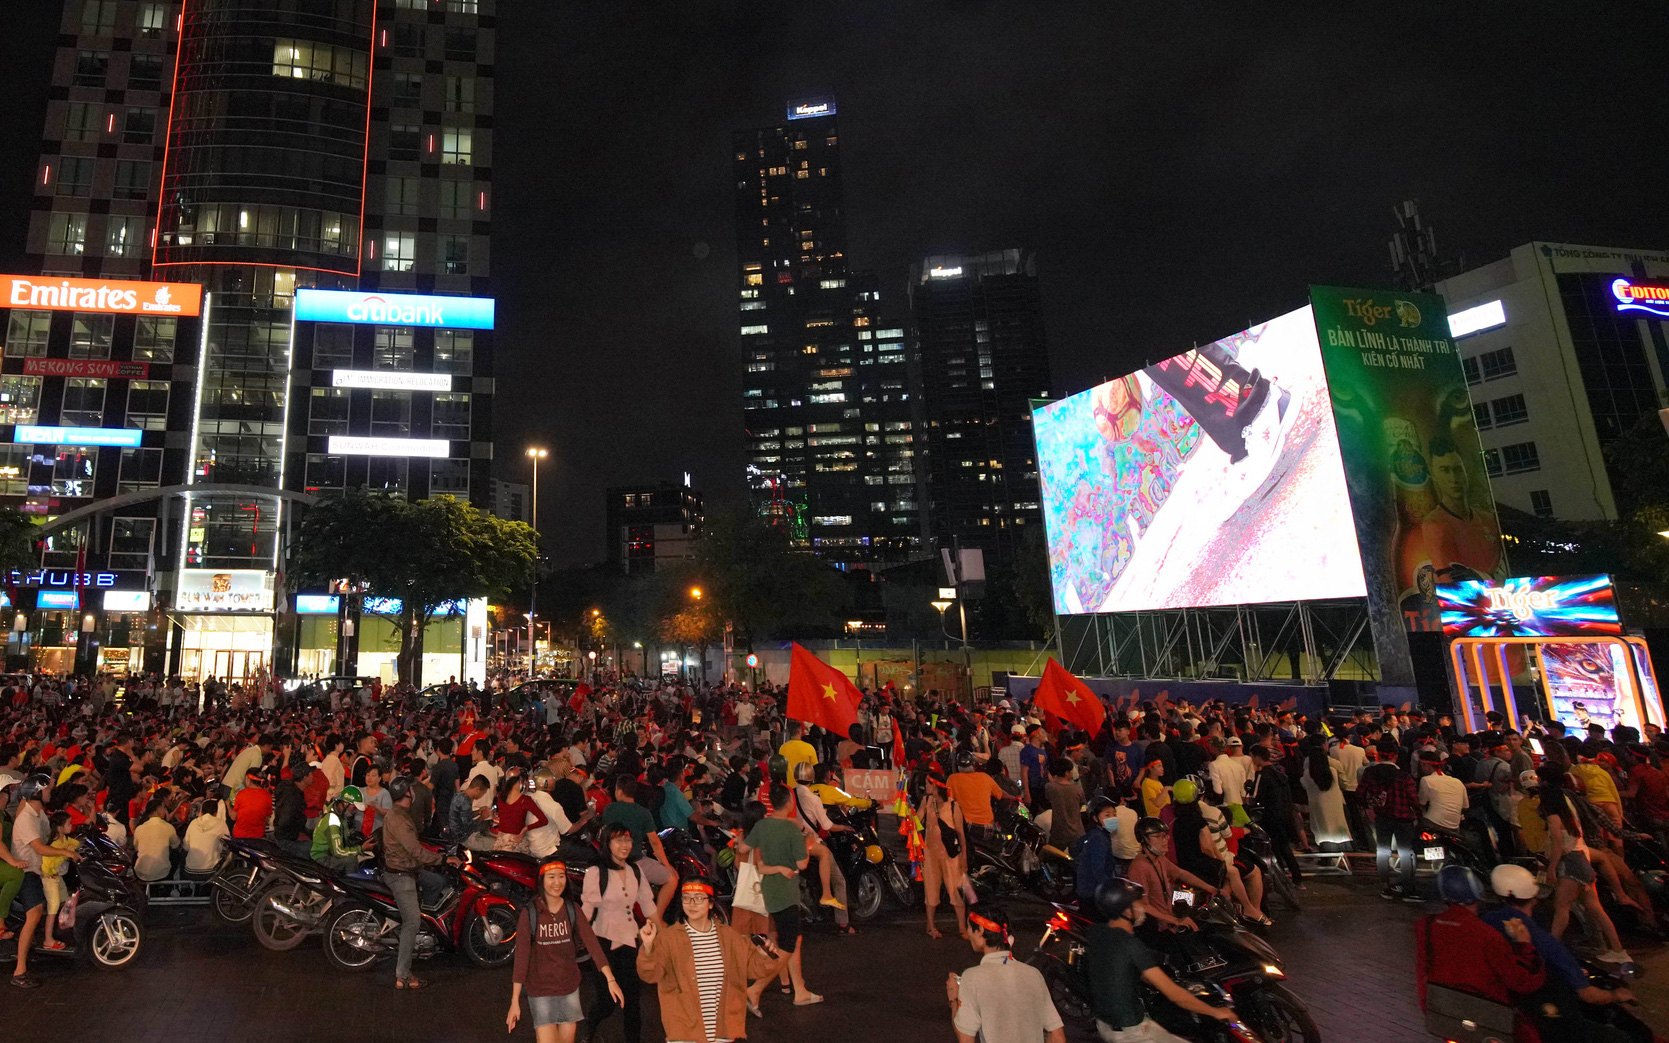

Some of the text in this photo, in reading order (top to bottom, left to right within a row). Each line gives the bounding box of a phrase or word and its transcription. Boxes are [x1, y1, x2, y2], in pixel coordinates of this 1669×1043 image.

[10, 279, 137, 310] Emirates
[142, 302, 181, 312] Emirates
[347, 297, 444, 325] citibank
[1342, 298, 1392, 326] Tiger
[1327, 325, 1450, 354] BẢN LĨNH LÀ THÀNH TRÌ
[26, 360, 115, 375] MEKONG SUN
[1361, 351, 1425, 370] KIÊN CỐ NHẤT
[1484, 583, 1560, 620] Tiger
[539, 920, 568, 937] MERCI
